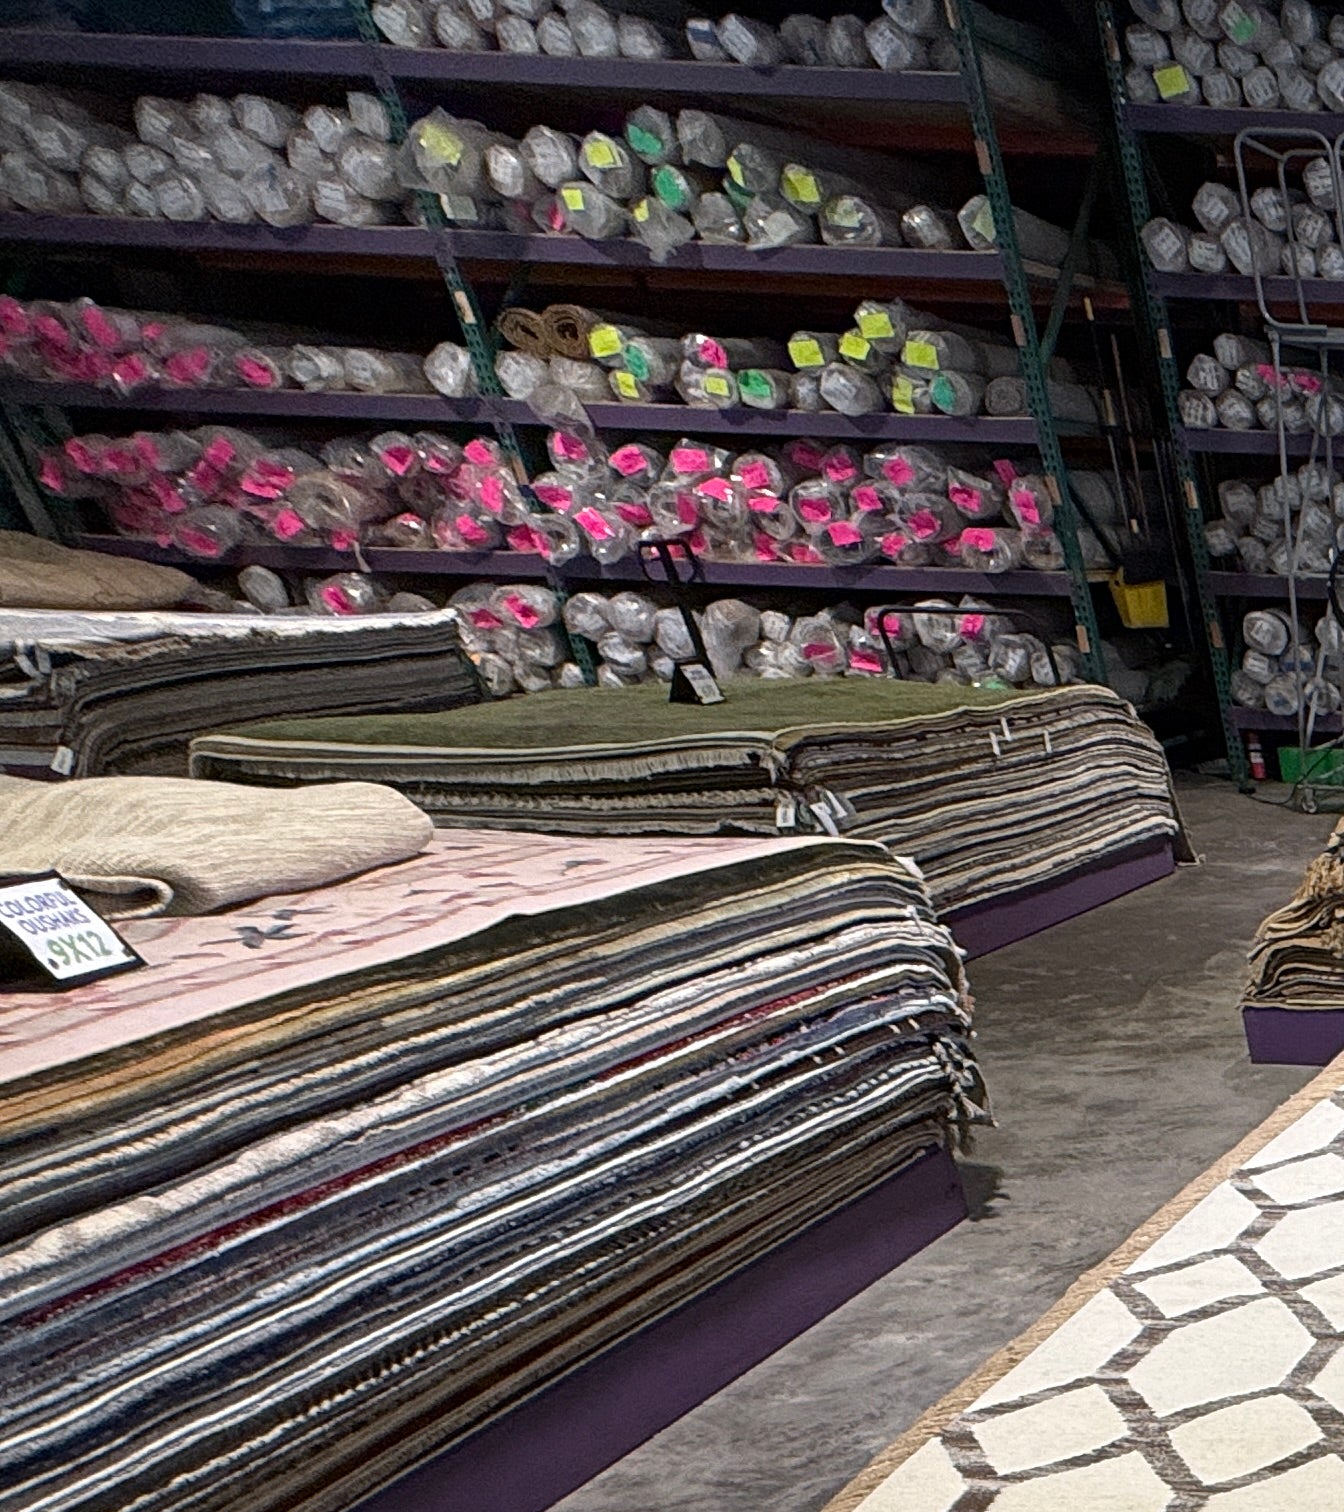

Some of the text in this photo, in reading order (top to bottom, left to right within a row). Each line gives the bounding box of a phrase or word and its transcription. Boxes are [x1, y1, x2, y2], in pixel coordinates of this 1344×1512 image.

[0, 890, 77, 919] COLORFUL
[17, 907, 91, 936] OUSHAKS
[46, 930, 113, 967] 9X12
